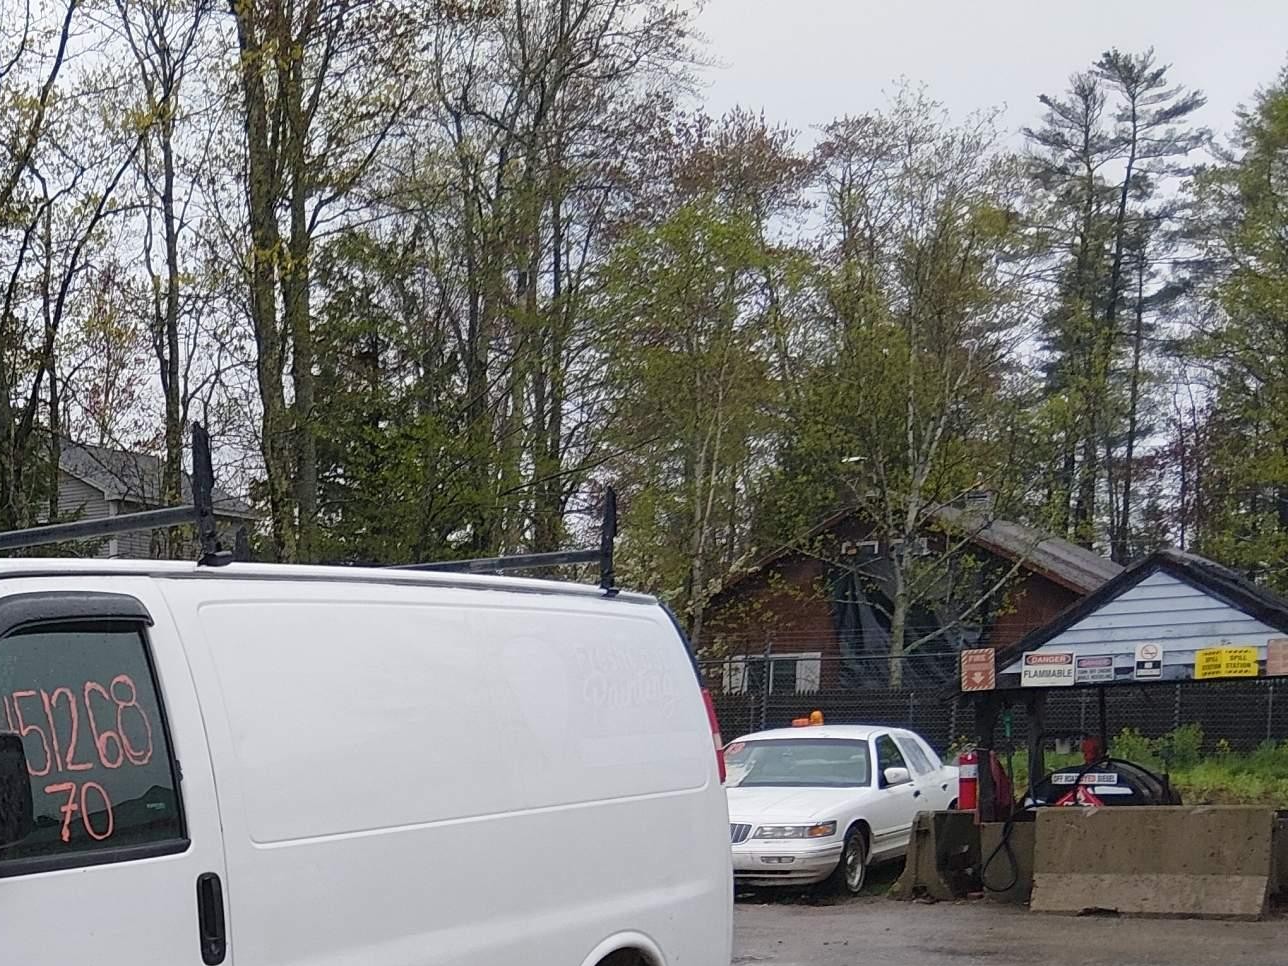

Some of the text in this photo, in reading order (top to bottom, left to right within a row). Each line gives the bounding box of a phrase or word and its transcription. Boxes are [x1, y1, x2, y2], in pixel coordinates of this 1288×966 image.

[1031, 655, 1067, 664] DANGER
[1023, 668, 1073, 679] FLAMMABLE
[44, 781, 115, 843] 70
